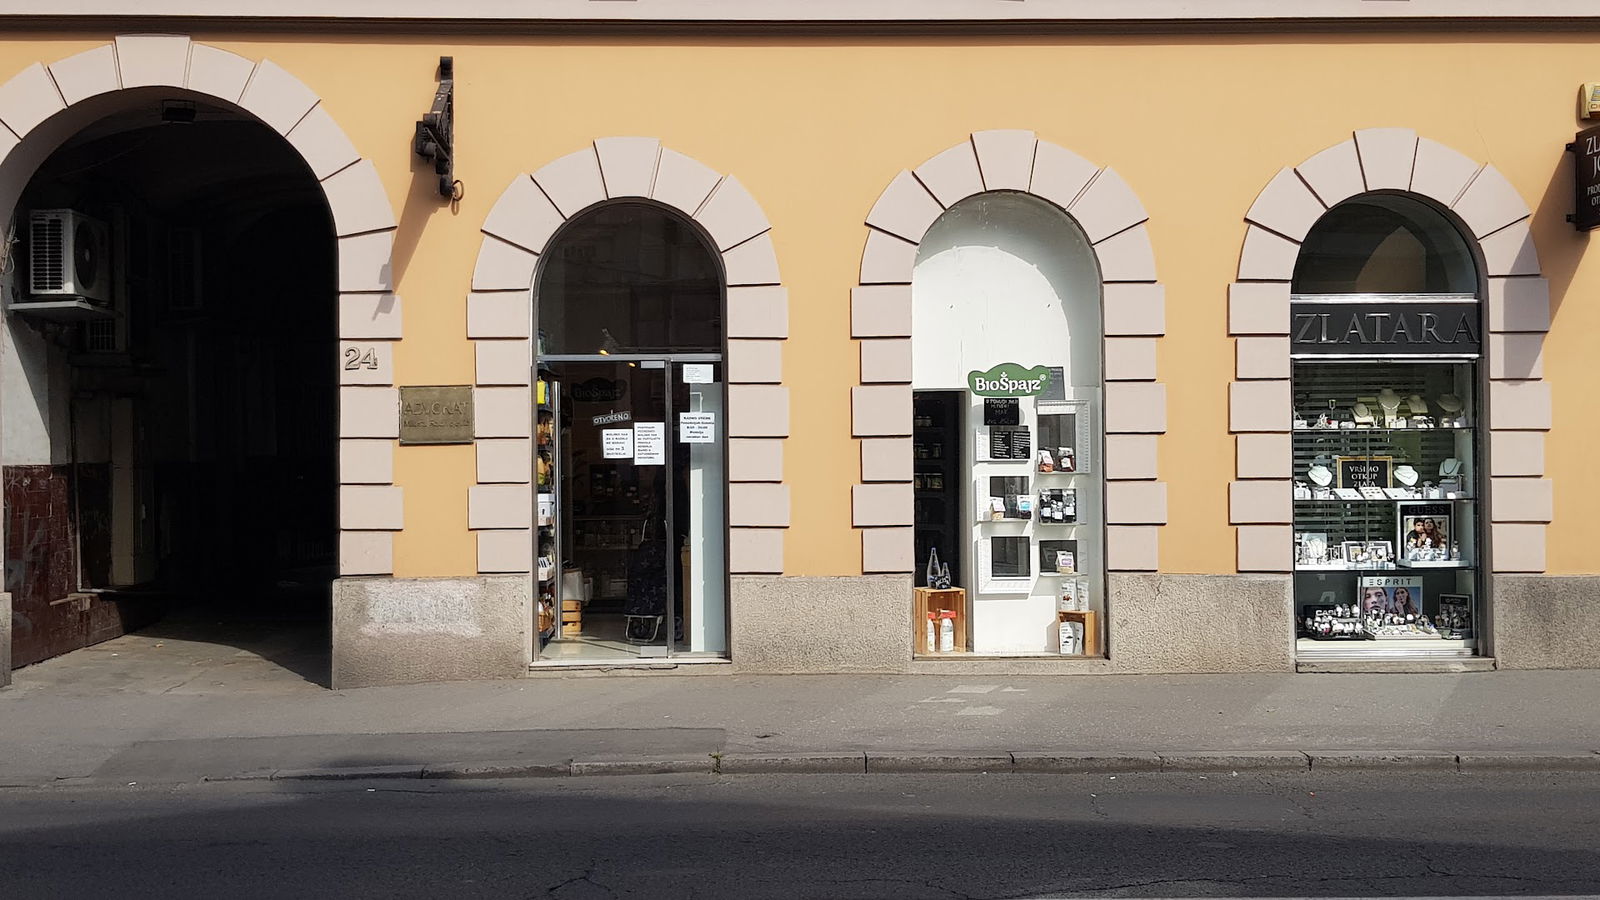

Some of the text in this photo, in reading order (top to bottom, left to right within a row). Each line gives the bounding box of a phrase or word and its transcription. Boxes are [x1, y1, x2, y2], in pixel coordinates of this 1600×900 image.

[1293, 312, 1480, 345] ZLATARA
[344, 346, 378, 371] 24
[593, 412, 629, 425] OTVORENO
[1408, 505, 1445, 514] GUESS
[1369, 578, 1412, 586] ESPRIT
